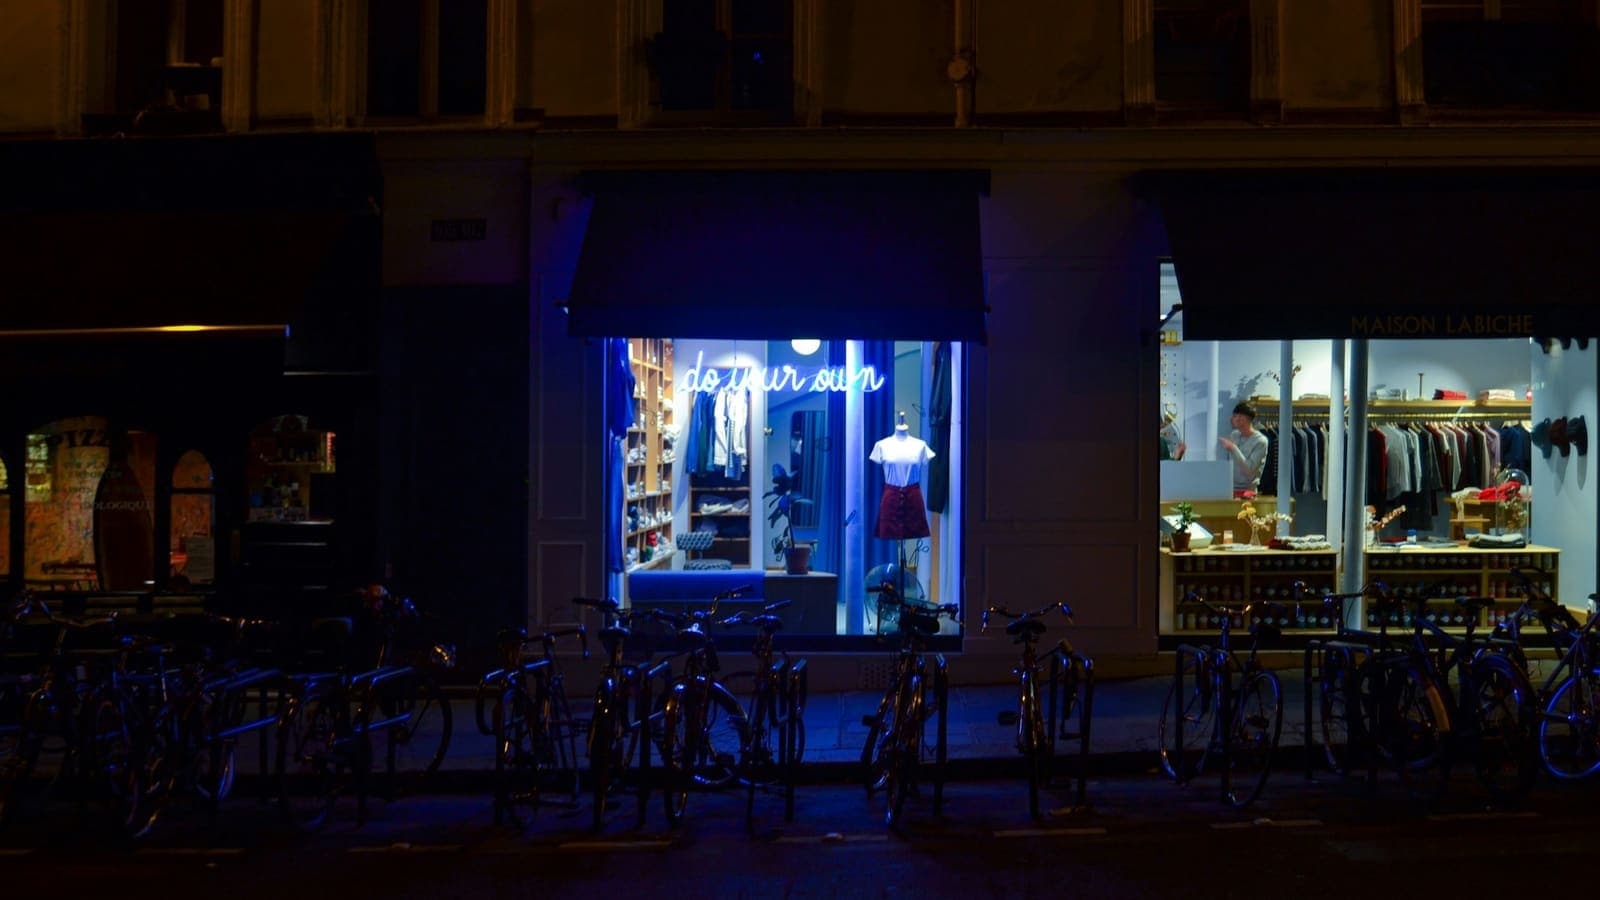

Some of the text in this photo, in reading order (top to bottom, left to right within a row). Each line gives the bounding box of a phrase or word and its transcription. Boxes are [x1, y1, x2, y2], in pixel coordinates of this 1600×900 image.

[1351, 314, 1535, 334] MAISON LABICHE
[677, 350, 721, 393] do
[808, 364, 885, 393] own
